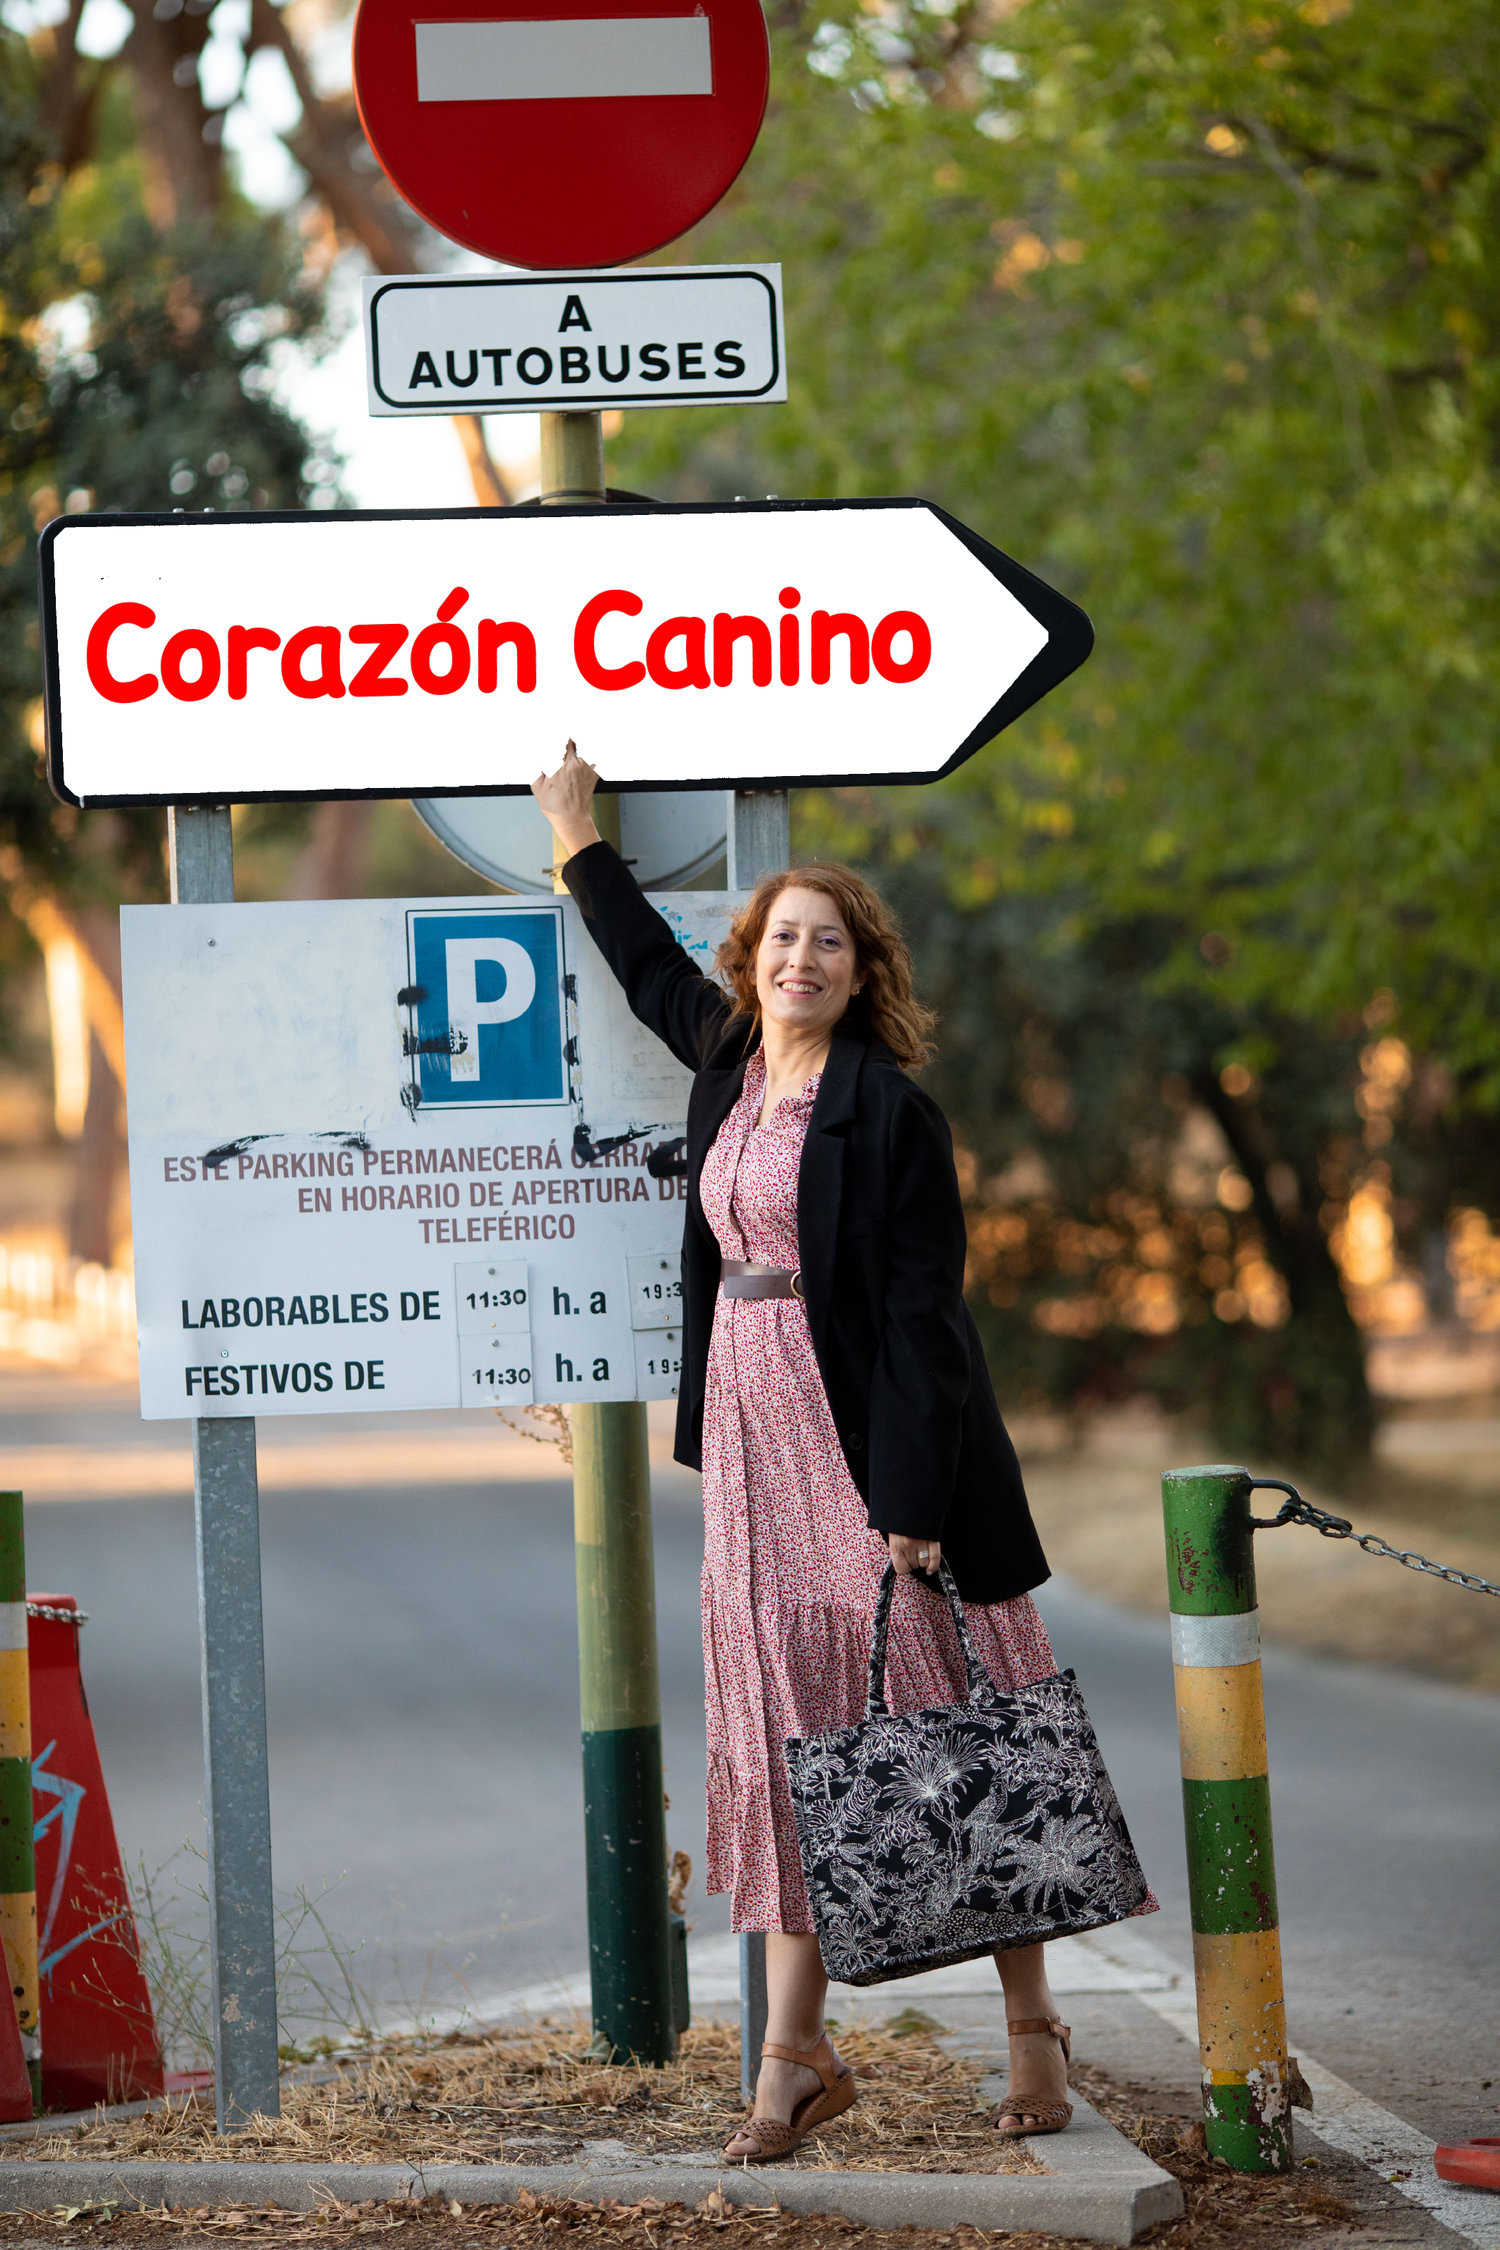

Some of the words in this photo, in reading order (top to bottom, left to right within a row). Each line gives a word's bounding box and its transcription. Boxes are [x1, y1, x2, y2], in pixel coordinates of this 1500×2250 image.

[558, 295, 592, 332] A
[408, 340, 746, 390] AUTOBUSES
[86, 586, 537, 703] Corazón
[573, 587, 932, 692] Canino
[444, 936, 536, 1082] P
[163, 1155, 230, 1183] ESTE
[237, 1151, 354, 1180] PARKING
[362, 1138, 563, 1177] PERMANECERÁ
[298, 1187, 333, 1213] EN
[341, 1182, 460, 1212] HORARIO
[469, 1180, 504, 1207] DE
[511, 1176, 651, 1206] APERTURA
[417, 1210, 576, 1244] TELEFÉRICO
[181, 1292, 390, 1330] LABORABLES
[400, 1290, 442, 1322] DE
[466, 1288, 528, 1310] 11:30
[552, 1286, 580, 1316] h.
[589, 1290, 608, 1315] a
[642, 1281, 683, 1299] 19:3
[185, 1362, 334, 1397] FESTIVOS
[344, 1360, 386, 1391] DE
[472, 1367, 532, 1386] 11:30
[555, 1353, 583, 1383] h.
[592, 1357, 610, 1382] a
